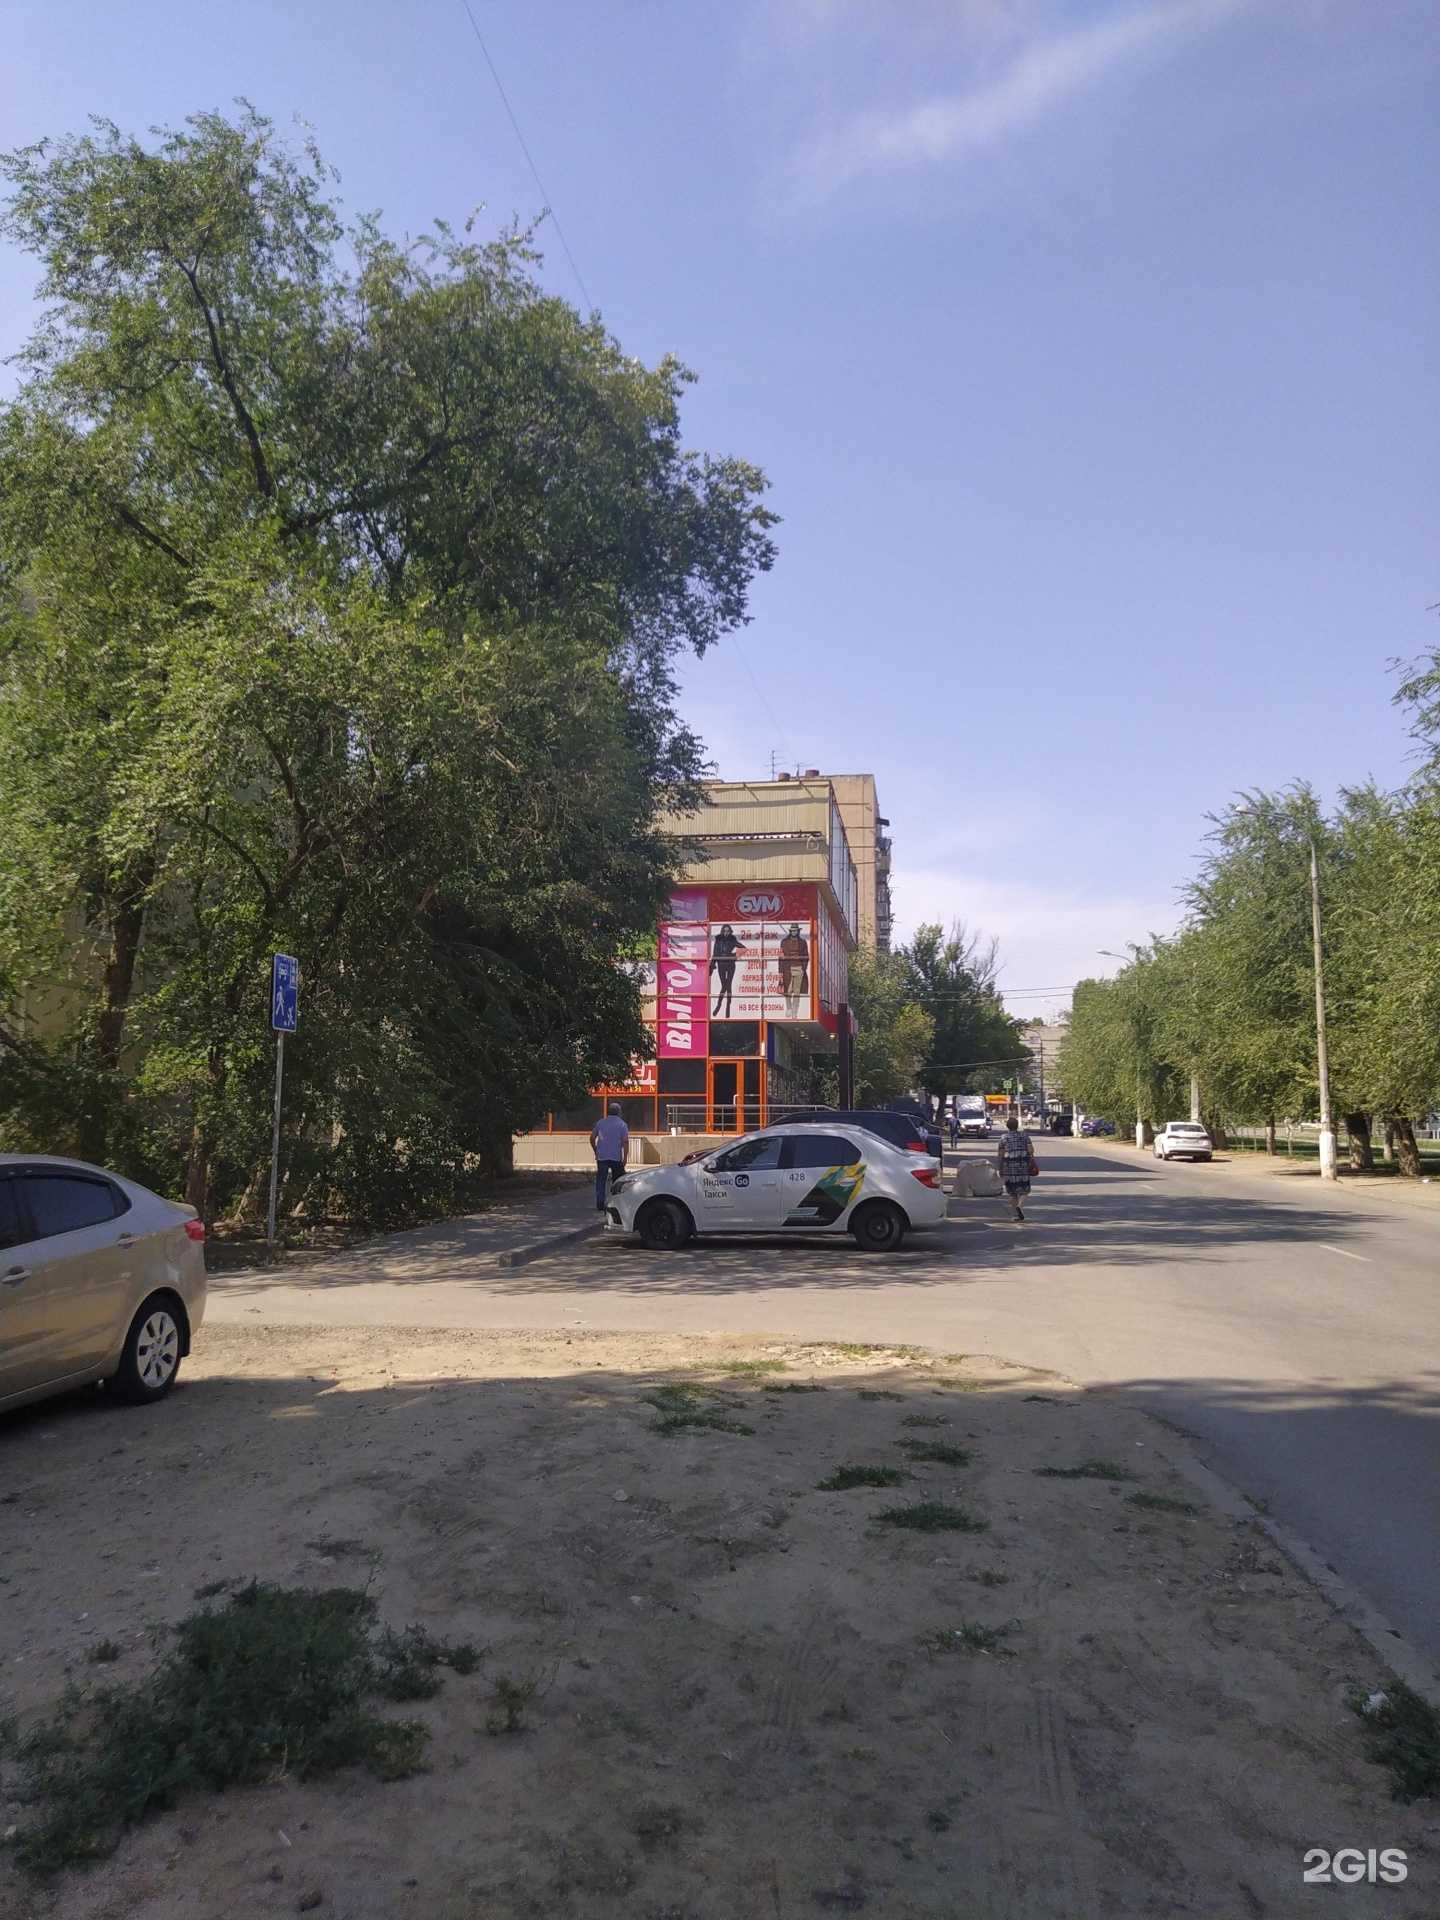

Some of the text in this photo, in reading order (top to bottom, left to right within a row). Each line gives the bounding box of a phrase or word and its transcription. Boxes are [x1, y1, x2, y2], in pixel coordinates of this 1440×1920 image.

[738, 895, 780, 913] БУМ
[703, 1176, 748, 1186] Яндекс Go
[789, 1173, 805, 1181] 428
[704, 1190, 727, 1198] Такси
